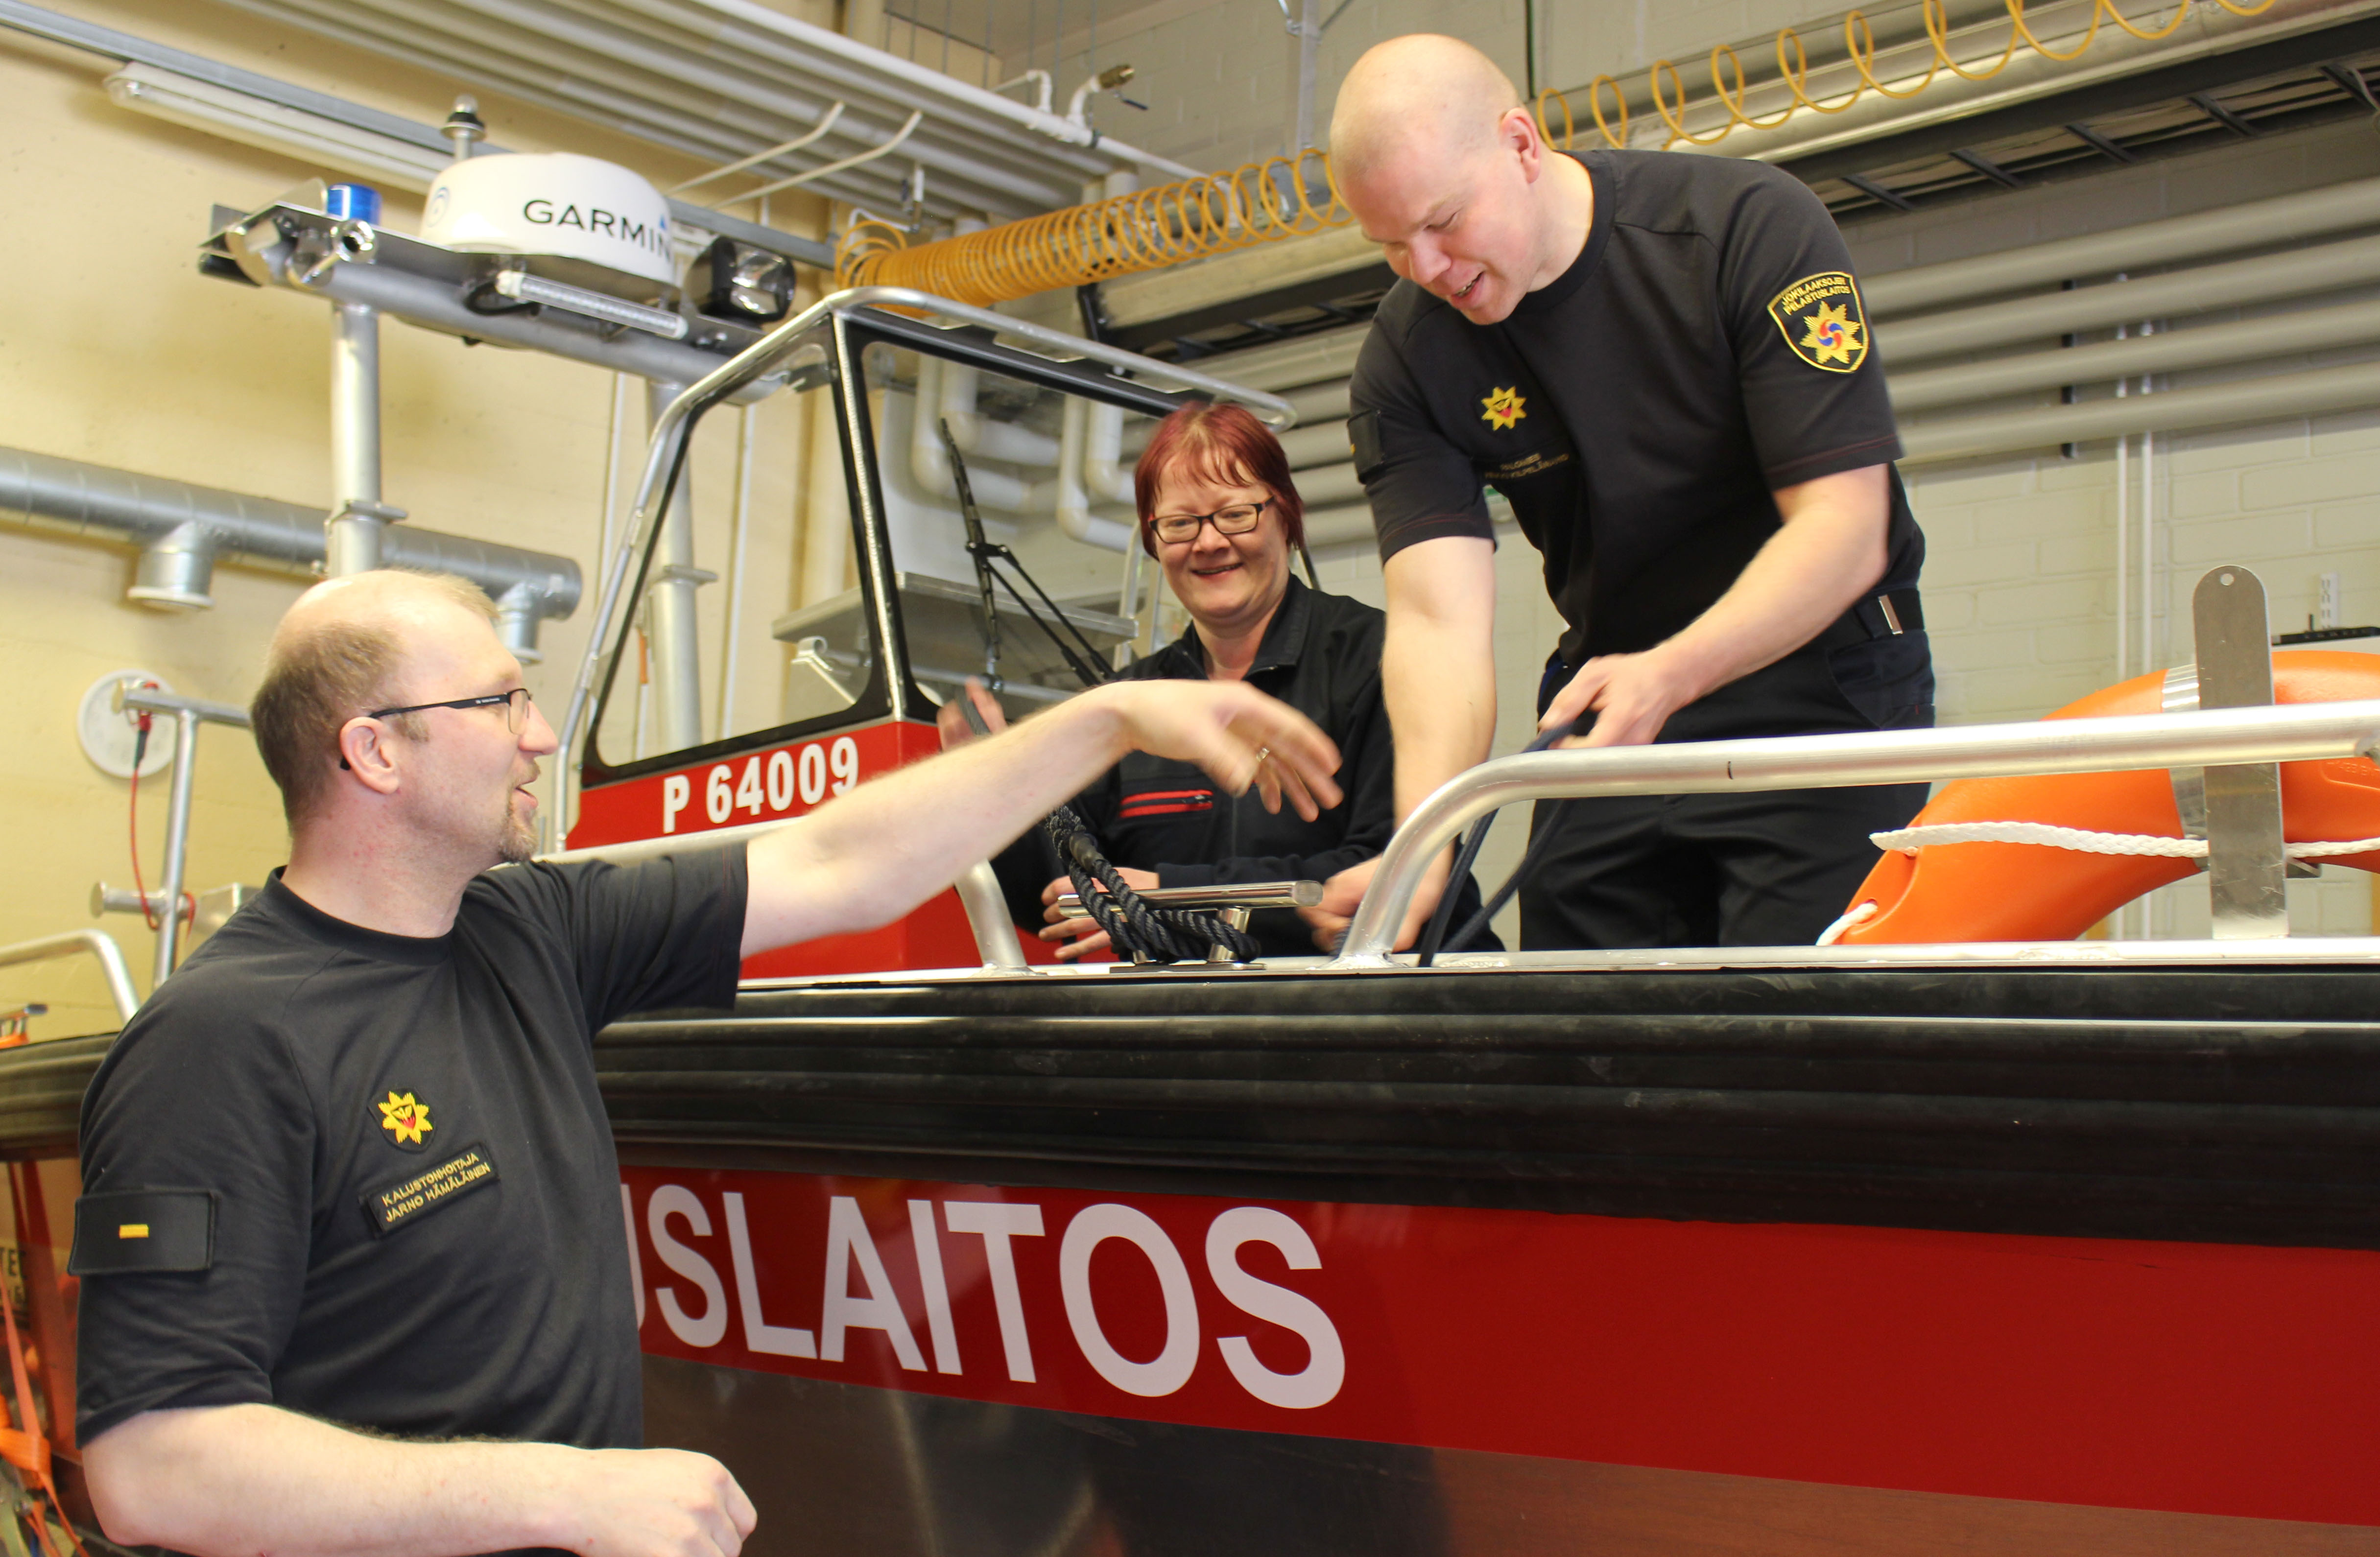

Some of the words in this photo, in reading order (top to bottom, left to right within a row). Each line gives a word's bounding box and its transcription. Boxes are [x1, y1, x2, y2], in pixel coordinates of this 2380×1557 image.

[524, 199, 671, 262] GARMIN
[1783, 285, 1852, 316] PELASTUSLAITOS
[663, 774, 690, 834] P
[706, 736, 859, 824] 64009
[381, 1152, 479, 1207] KALUSTONHOITAJA
[385, 1195, 424, 1223] JARNO
[425, 1161, 491, 1202] HÄMÄLÄINEN
